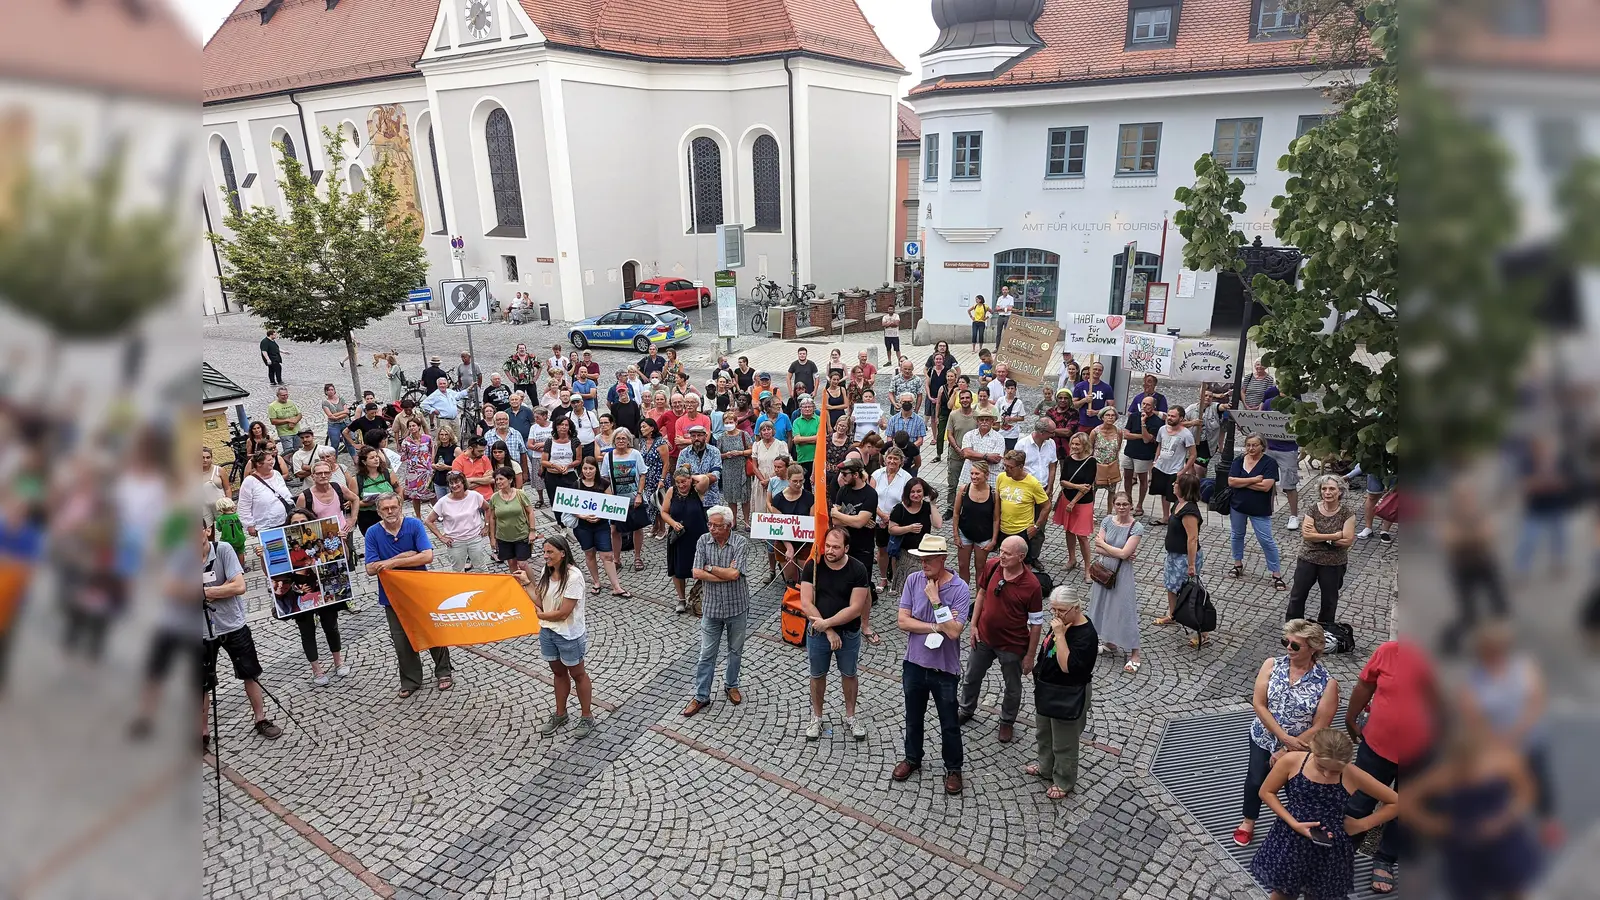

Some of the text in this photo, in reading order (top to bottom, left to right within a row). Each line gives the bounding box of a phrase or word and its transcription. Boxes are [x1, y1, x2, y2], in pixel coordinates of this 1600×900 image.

[1022, 223, 1045, 231] AMT
[1047, 221, 1068, 231] FÜR
[1070, 223, 1111, 231] KULTUR
[1073, 314, 1095, 324] HABT
[1191, 362, 1221, 372] Gesetze
[1261, 412, 1292, 420] Chance
[556, 492, 626, 515] Holt sie heim
[757, 513, 801, 525] Kindeswohl
[769, 525, 815, 539] hat Vorra
[429, 608, 521, 622] SEEBRÜCKE
